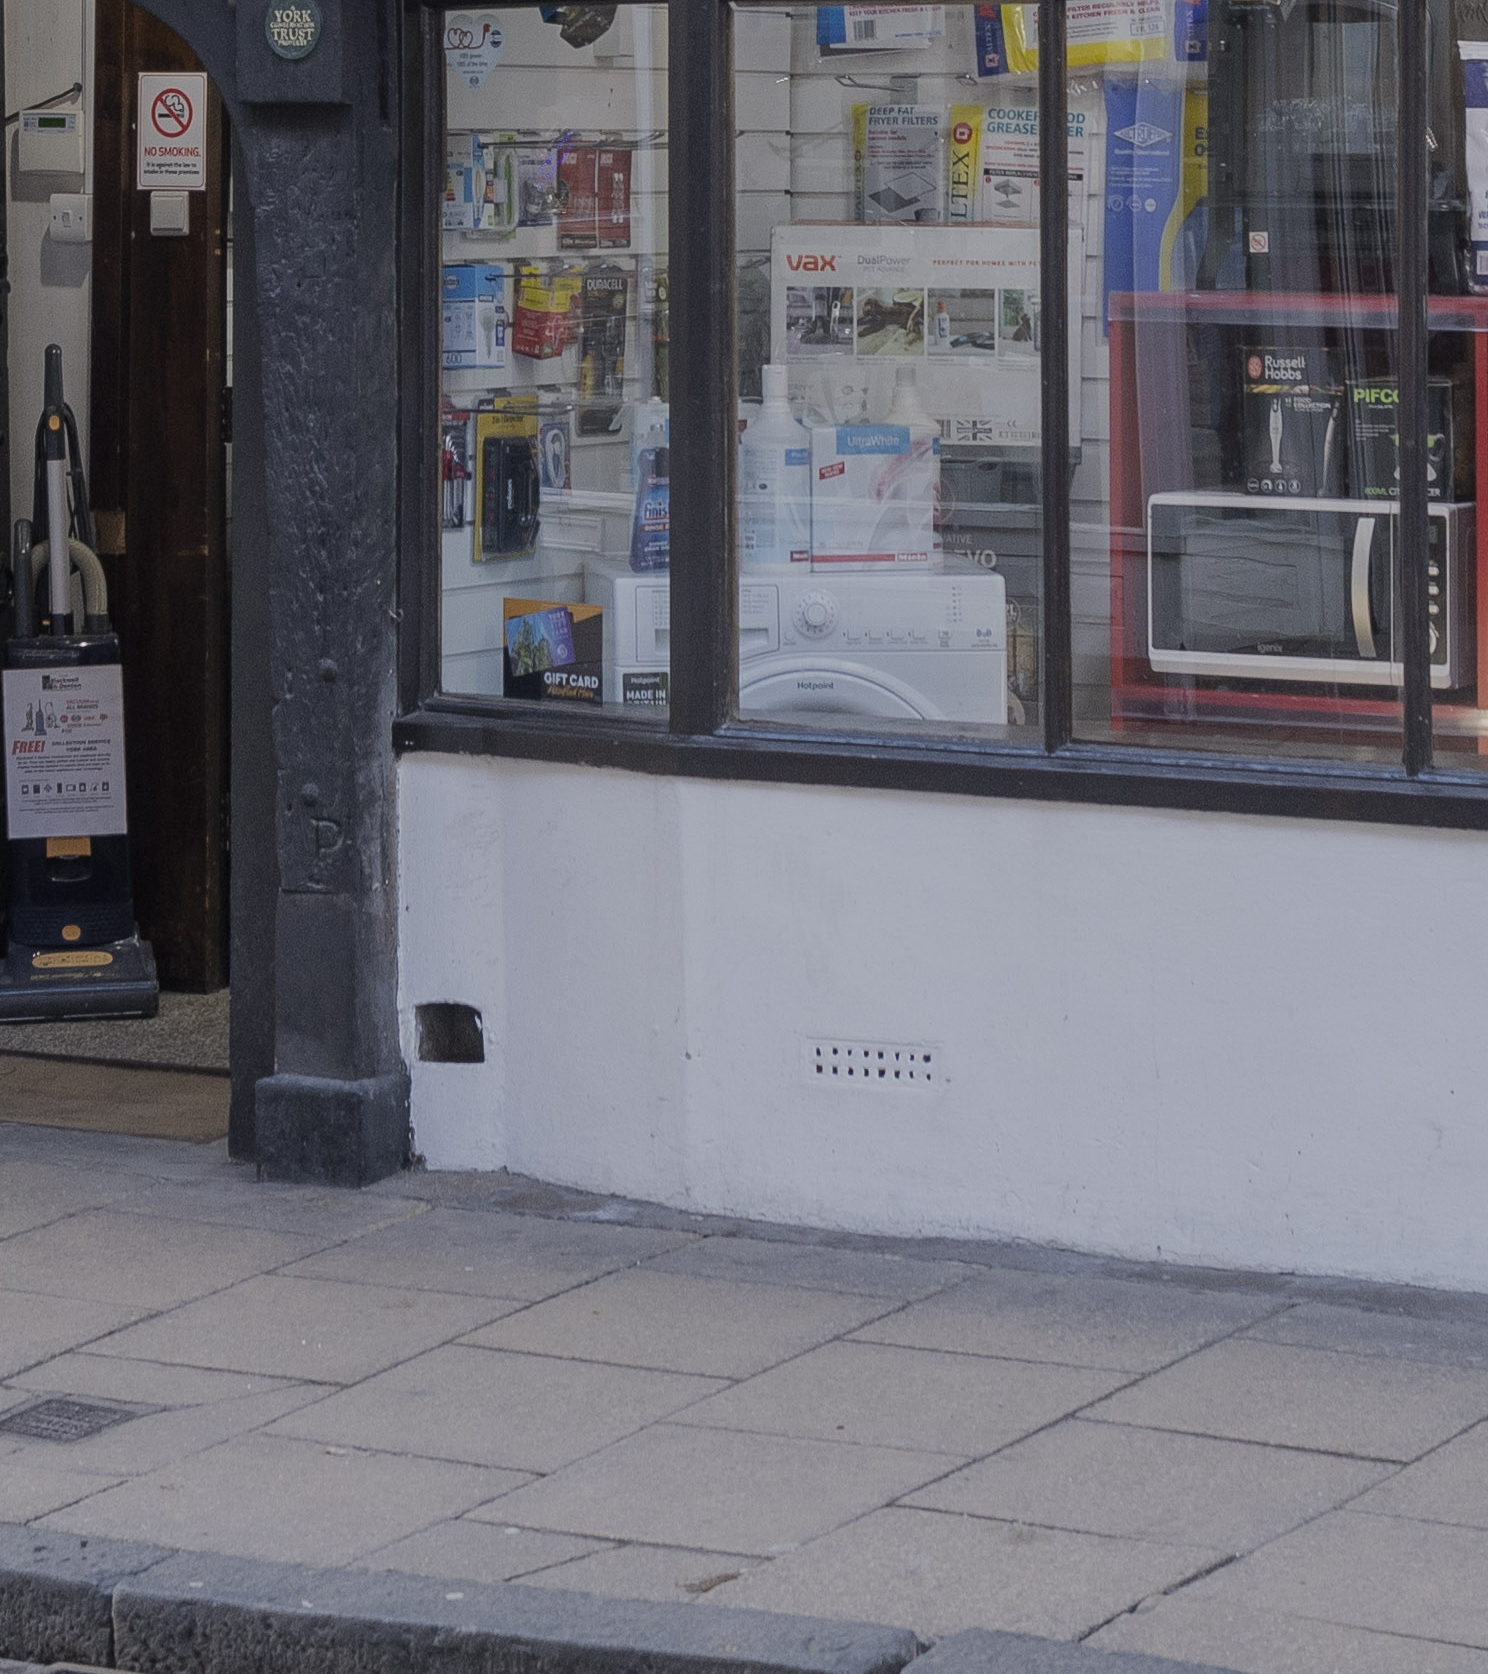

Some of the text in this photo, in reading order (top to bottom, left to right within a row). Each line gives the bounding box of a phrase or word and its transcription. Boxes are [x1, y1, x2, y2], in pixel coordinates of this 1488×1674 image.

[275, 10, 311, 22] YORK
[271, 28, 314, 40] TRUST
[869, 107, 915, 116] DEEP FAT
[869, 116, 938, 125] FRYER FILTERS
[987, 122, 1038, 134] GREASE
[145, 147, 157, 156] NO
[857, 255, 911, 266] DualPower
[587, 279, 623, 290] DURACELL
[1264, 355, 1305, 369] Russell
[1265, 367, 1302, 380] Hobbs
[847, 435, 900, 447] UltraWhite
[644, 500, 668, 519] finis
[544, 672, 599, 689] GIFT CARD
[797, 681, 834, 691] Hotpoint
[626, 690, 666, 700] MADE IN
[12, 741, 46, 755] FREE!
